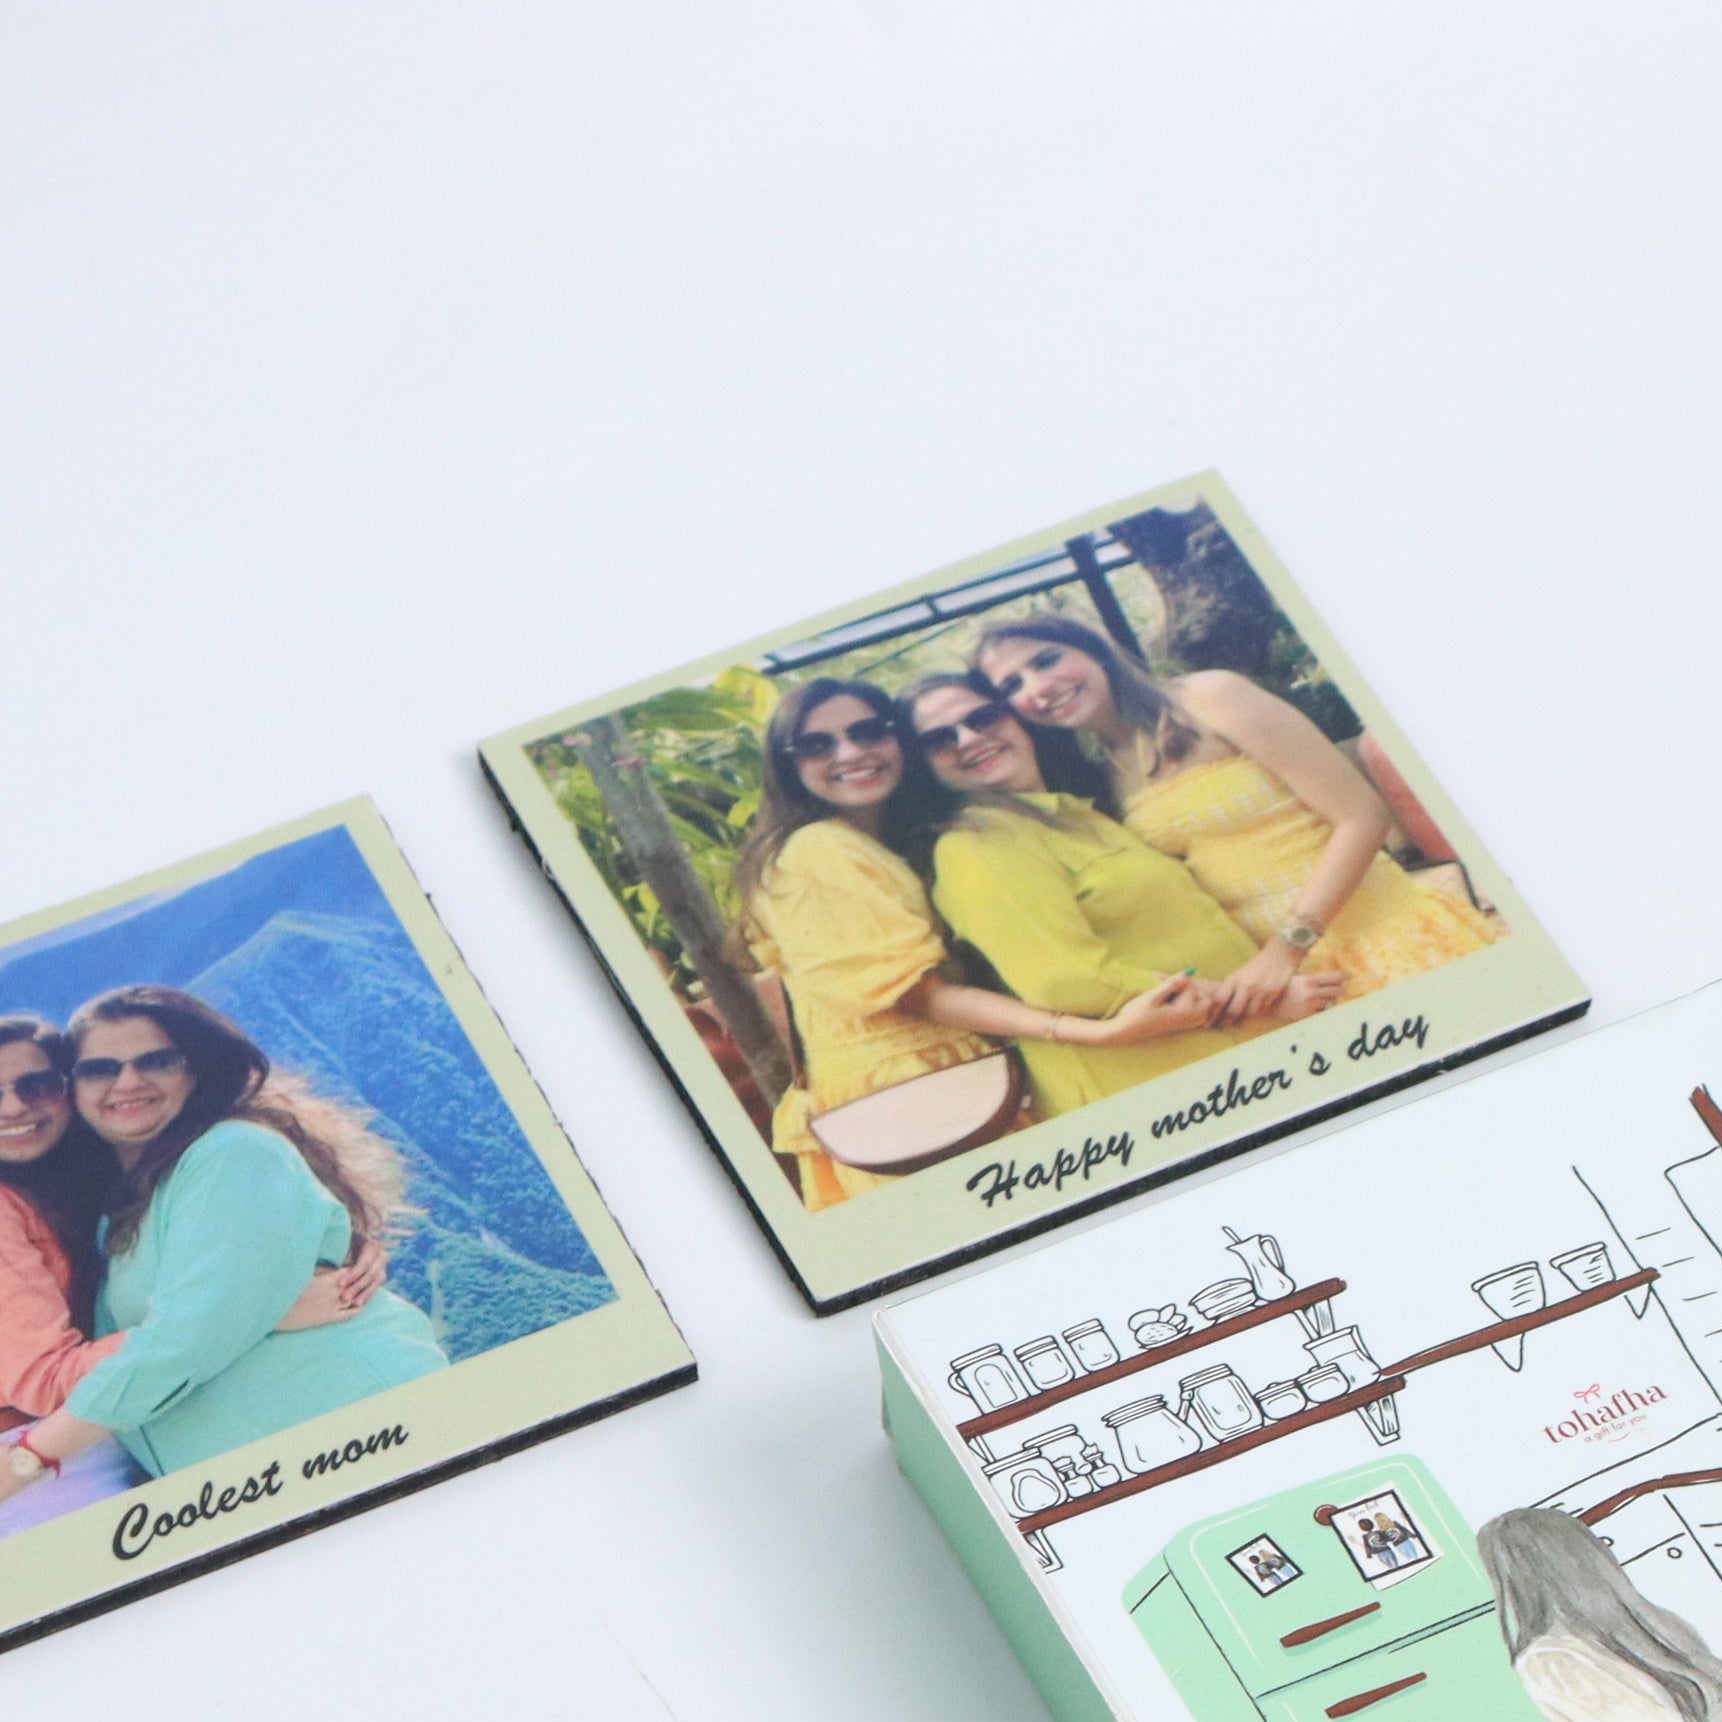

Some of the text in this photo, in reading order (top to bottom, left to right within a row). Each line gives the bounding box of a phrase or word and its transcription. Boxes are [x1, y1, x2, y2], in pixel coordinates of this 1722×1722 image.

[966, 1015, 1430, 1207] Happy mother's day
[1544, 1385, 1668, 1443] tohafha
[112, 1424, 409, 1561] Coolest mom
